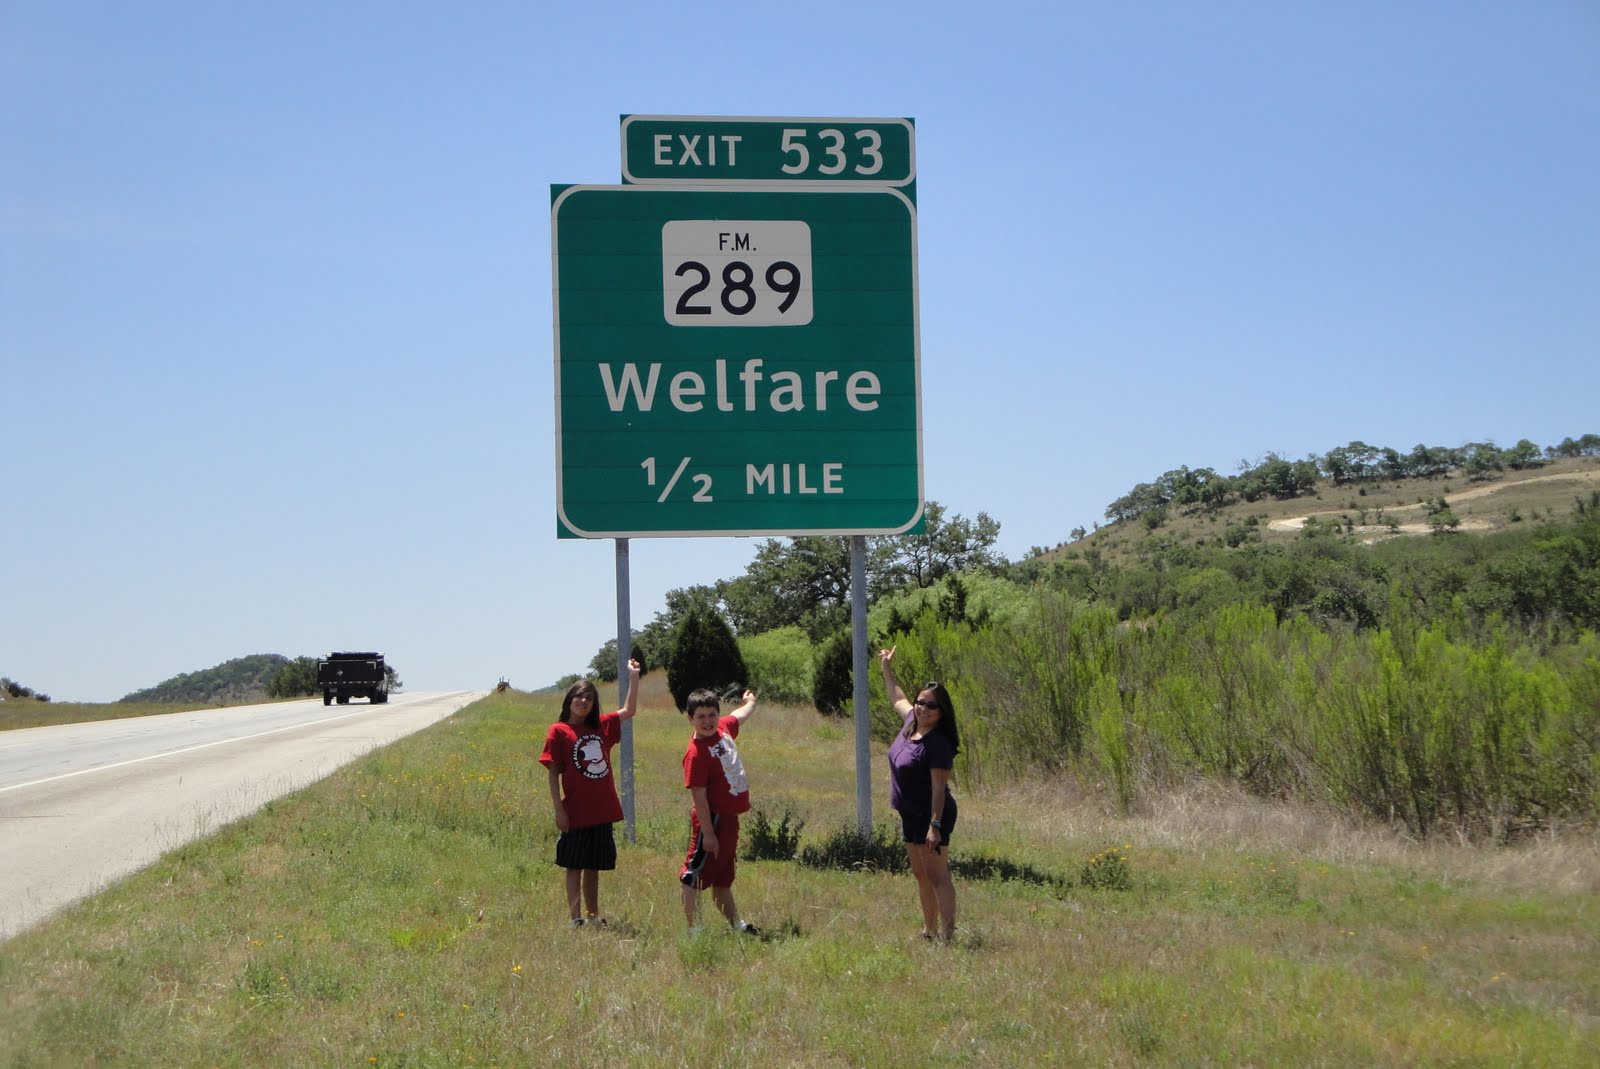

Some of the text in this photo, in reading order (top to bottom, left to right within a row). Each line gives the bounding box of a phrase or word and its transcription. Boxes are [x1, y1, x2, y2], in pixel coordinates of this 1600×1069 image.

[653, 129, 883, 175] EXIT 533
[719, 233, 757, 251] F.M.
[674, 261, 801, 315] 289
[598, 359, 881, 412] Welfare
[746, 463, 844, 493] MILE
